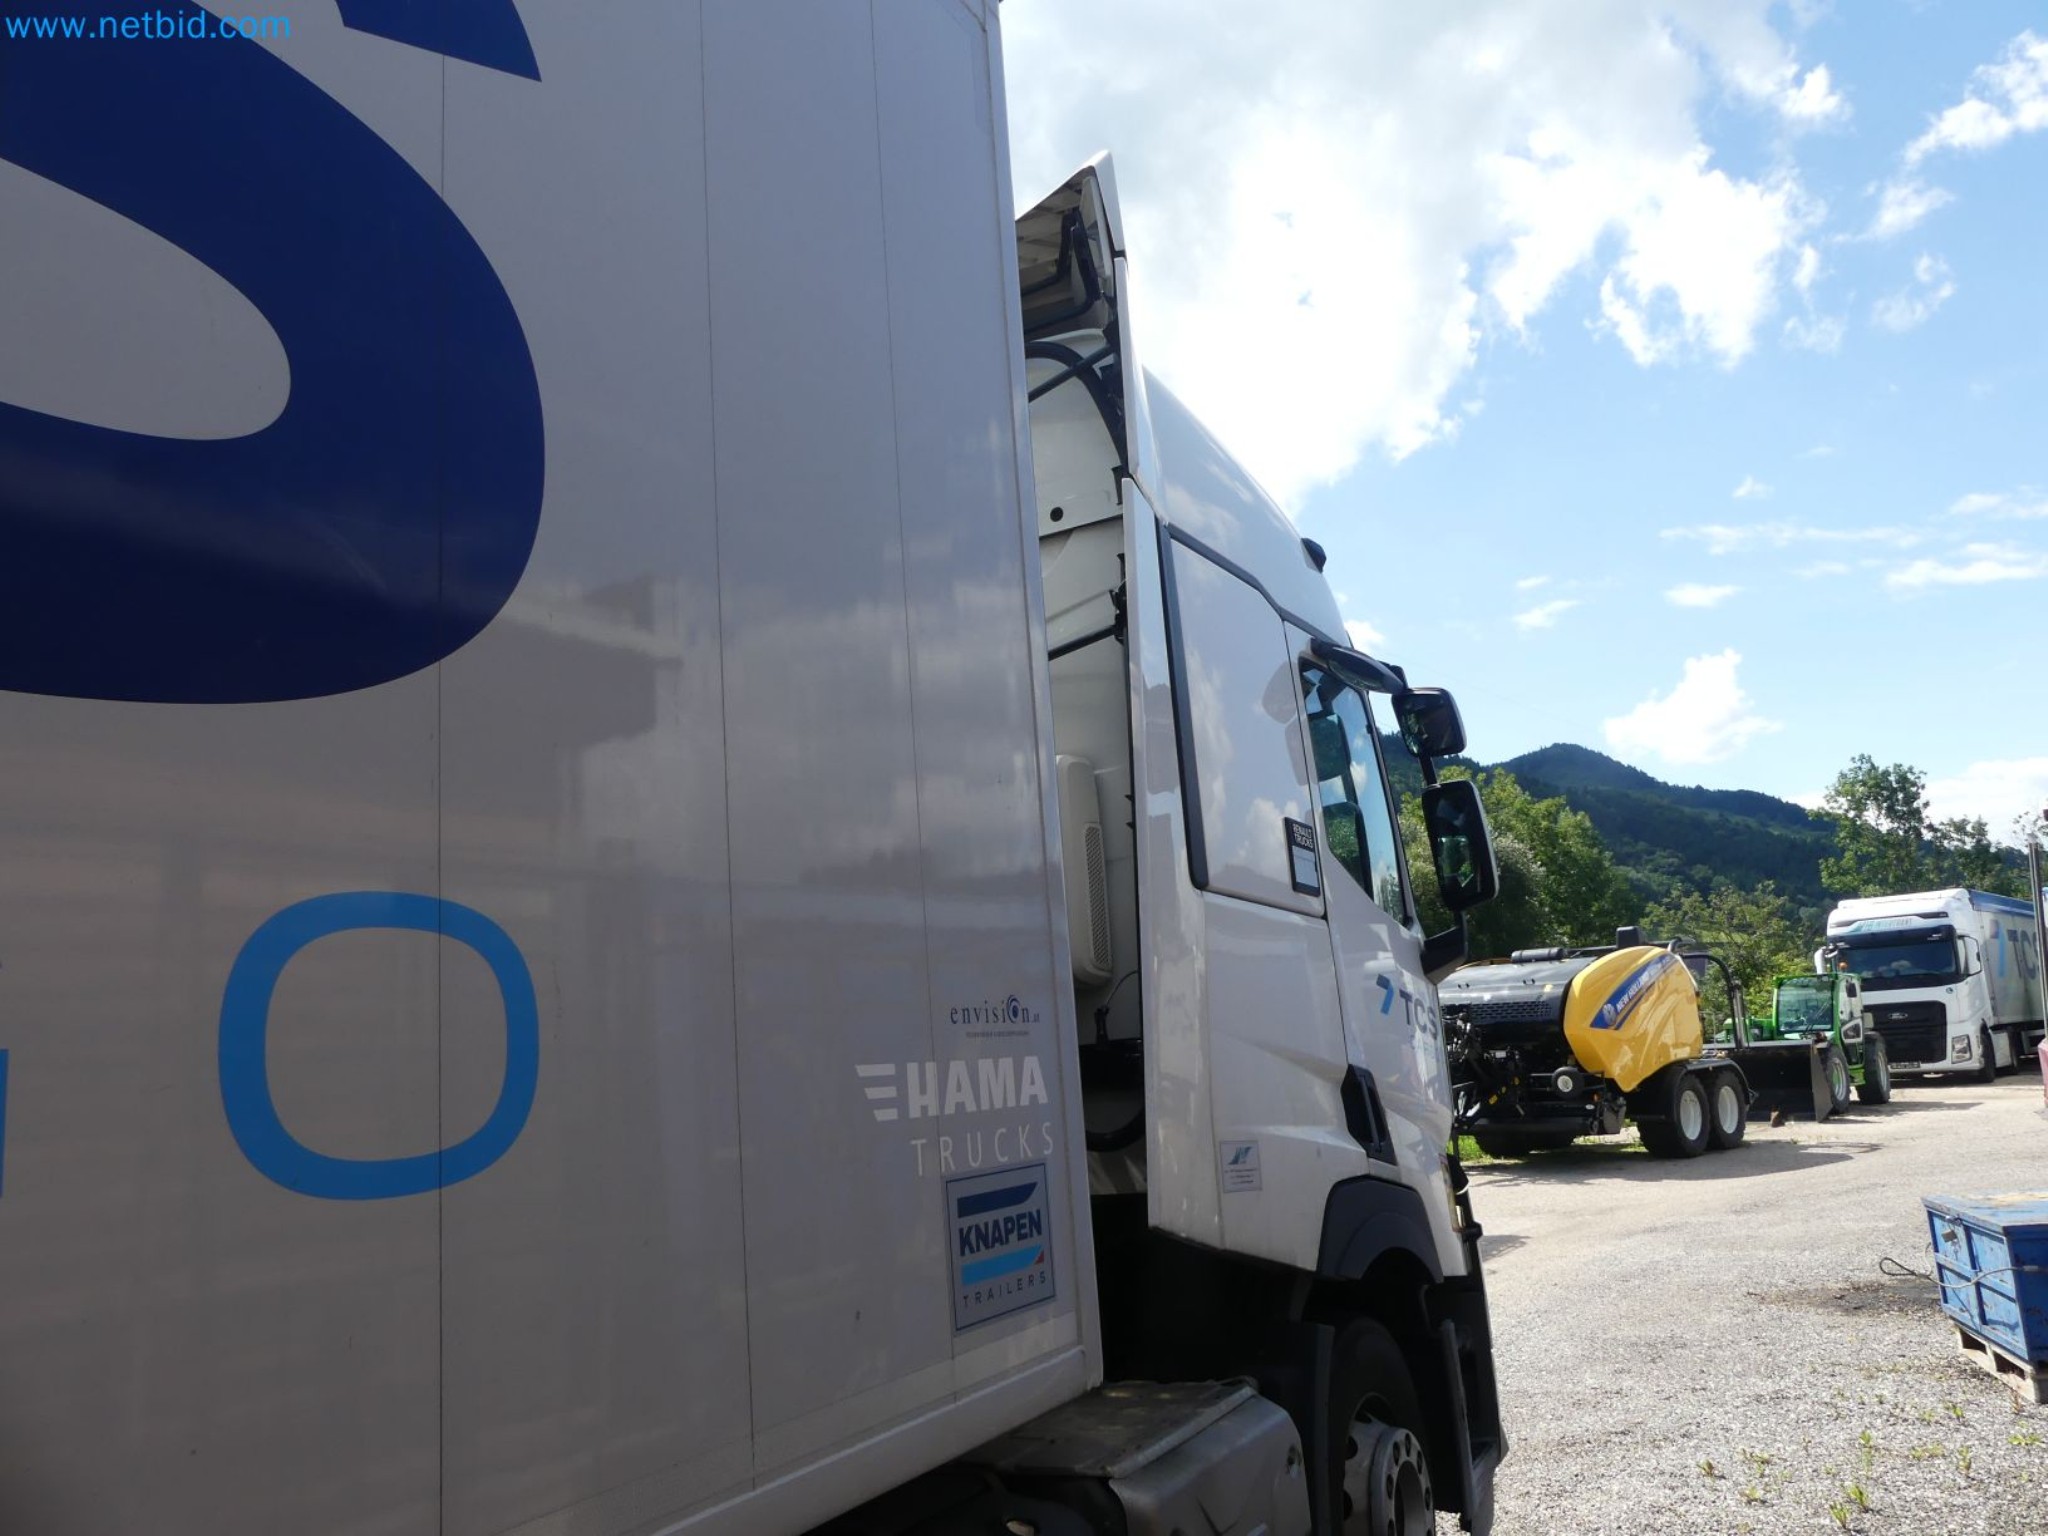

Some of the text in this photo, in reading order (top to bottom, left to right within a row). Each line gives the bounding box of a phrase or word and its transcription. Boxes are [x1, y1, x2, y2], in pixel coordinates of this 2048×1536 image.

[1399, 988, 1438, 1040] TCS
[910, 1122, 1054, 1177] TRUCKS
[958, 1208, 1043, 1257] KNAPEN
[963, 1271, 1047, 1308] TRAILERS
